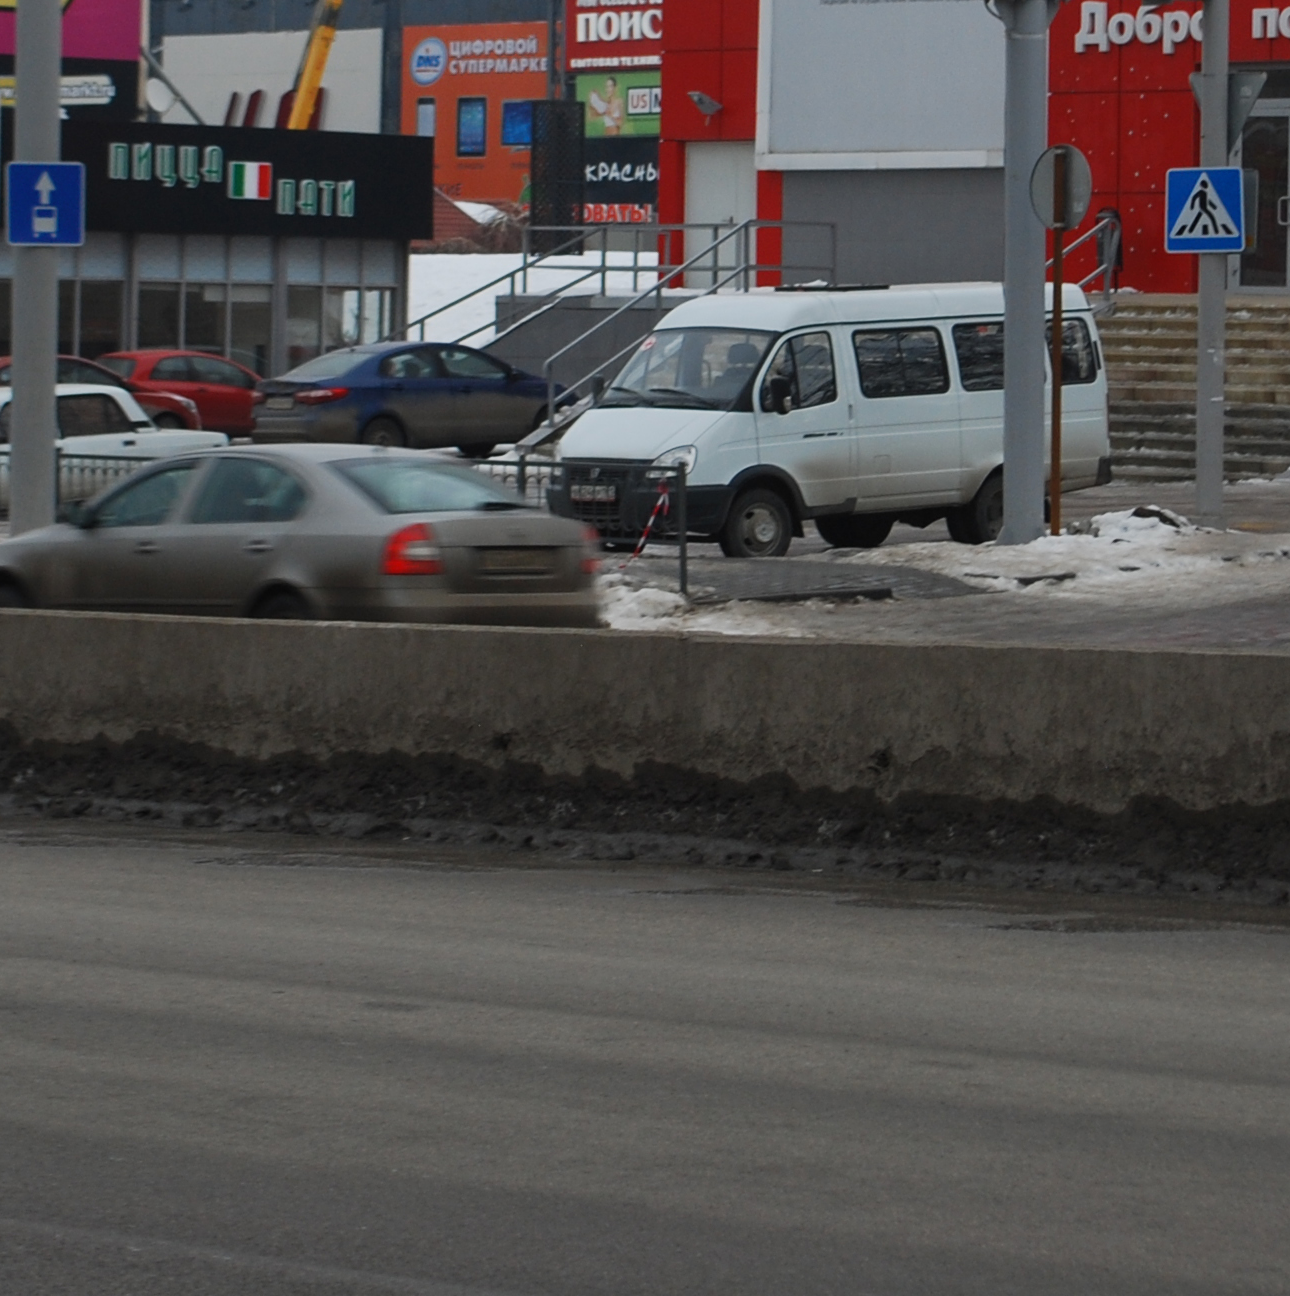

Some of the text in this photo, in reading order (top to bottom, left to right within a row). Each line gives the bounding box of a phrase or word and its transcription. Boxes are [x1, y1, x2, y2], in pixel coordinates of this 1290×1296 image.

[576, 9, 663, 42] ПОИС
[449, 34, 538, 58] ЦИФРОВОЙ
[416, 54, 442, 68] DNS
[449, 58, 548, 75] СУПЕРМАРКЕ
[630, 94, 648, 109] US
[108, 142, 223, 189] ПИЦЦА
[275, 178, 356, 217] ПАТИ
[583, 203, 653, 224] ОВАТЬ!
